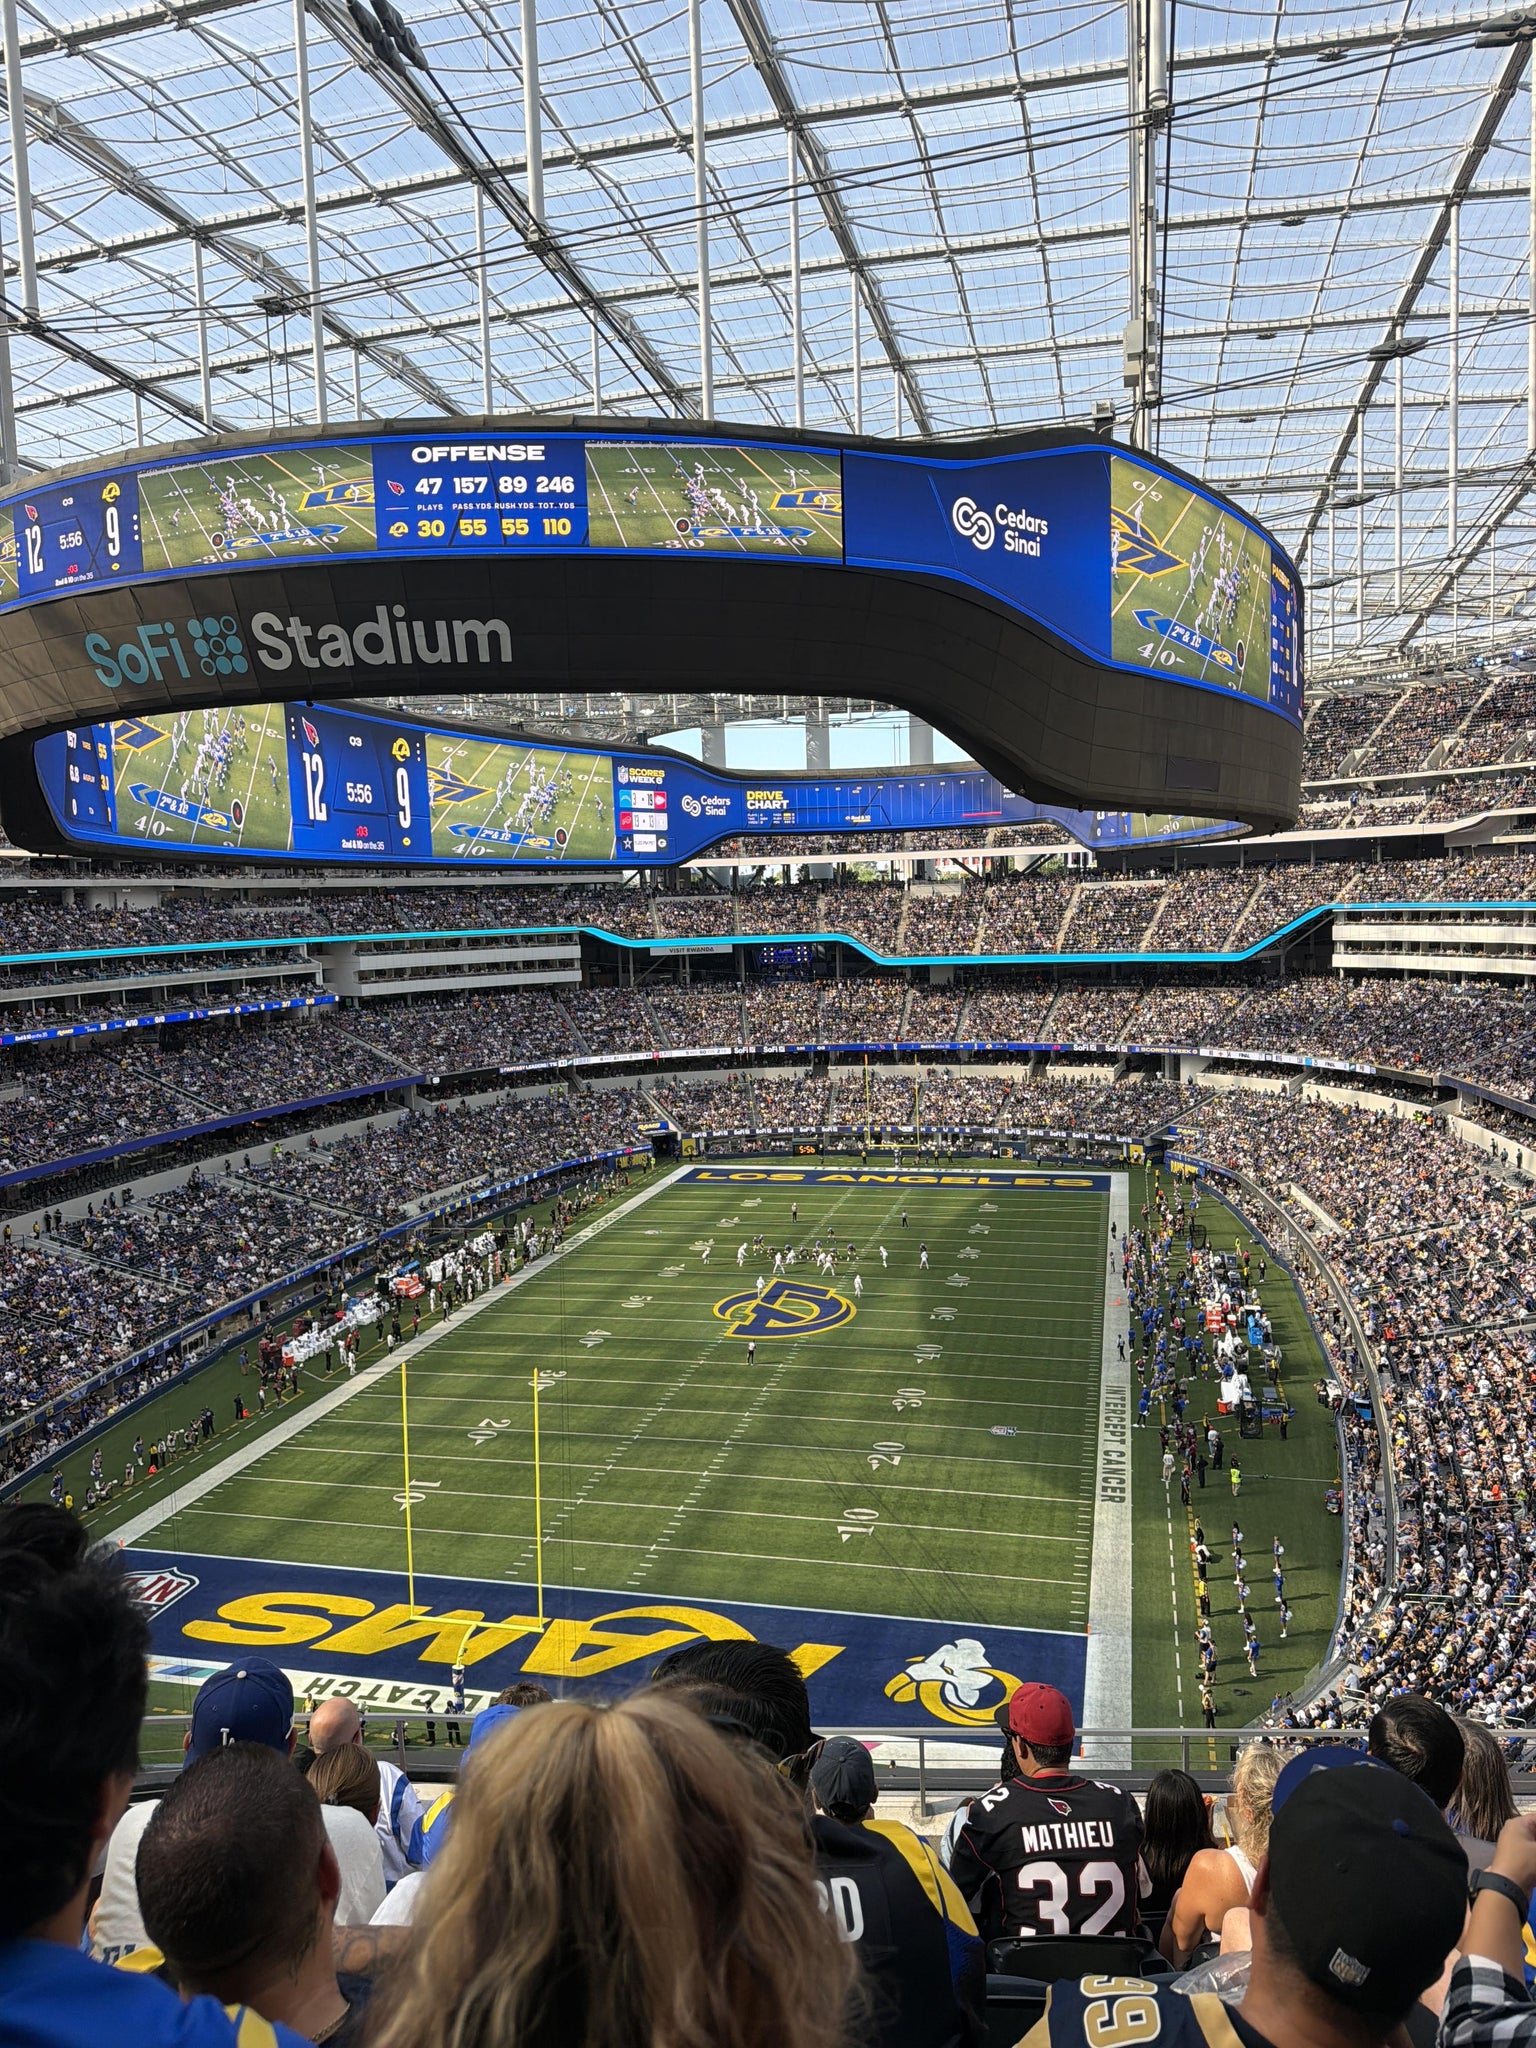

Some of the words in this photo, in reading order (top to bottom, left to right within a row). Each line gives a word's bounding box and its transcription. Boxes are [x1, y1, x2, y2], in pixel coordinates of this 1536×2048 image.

[411, 445, 545, 463] OFFENSE
[415, 478, 443, 495] 47
[453, 477, 488, 494] 157
[499, 476, 527, 493] 89
[536, 476, 575, 493] 246
[417, 520, 445, 537] 30
[459, 519, 487, 536] 55
[502, 518, 529, 535] 55
[542, 518, 572, 535] 110
[995, 503, 1048, 535] Cedars
[59, 531, 83, 549] 5:56
[106, 506, 121, 557] 9
[25, 525, 44, 575] 12
[1004, 530, 1041, 557] Sinai
[84, 621, 191, 688] SoFi
[250, 604, 513, 671] Stadium
[1137, 642, 1176, 666] 40
[70, 765, 79, 783] 6.8
[629, 767, 665, 778] SCORES
[629, 776, 655, 784] WEEK
[302, 752, 327, 821] 12
[346, 782, 372, 804] 5:56
[746, 790, 784, 801] DRIVE
[72, 799, 77, 816] 0
[396, 767, 411, 829] 9
[700, 795, 731, 806] Cedars
[746, 799, 789, 810] CHART
[705, 805, 727, 816] Sinai
[134, 815, 165, 837] 40
[452, 843, 487, 856] 40
[669, 946, 685, 954] VISIT
[687, 945, 714, 954] RWANDA
[734, 1046, 748, 1054] SoFi
[763, 1045, 778, 1053] SoFi
[504, 1065, 525, 1073] FANTASY
[526, 1062, 547, 1070] LEADERS
[798, 1145, 816, 1156] 5:56
[696, 1171, 804, 1181] LOS
[815, 1174, 1094, 1187] ANGELES
[434, 1197, 472, 1217] RAMS
[496, 1172, 538, 1193] HOUSE
[929, 1307, 958, 1321] 50
[913, 1344, 944, 1361] 40
[528, 1370, 567, 1387] 30
[892, 1388, 926, 1408] 30
[1103, 1385, 1126, 1445] INTERCEPT
[467, 1418, 511, 1440] 20
[867, 1441, 905, 1466] 20
[1101, 1450, 1126, 1504] CANCER
[392, 1478, 442, 1503] 10
[837, 1508, 880, 1537] 10
[302, 1677, 440, 1706] CATCH
[1021, 1821, 1114, 1853] MATHIEU
[1017, 1861, 1126, 1937] 32
